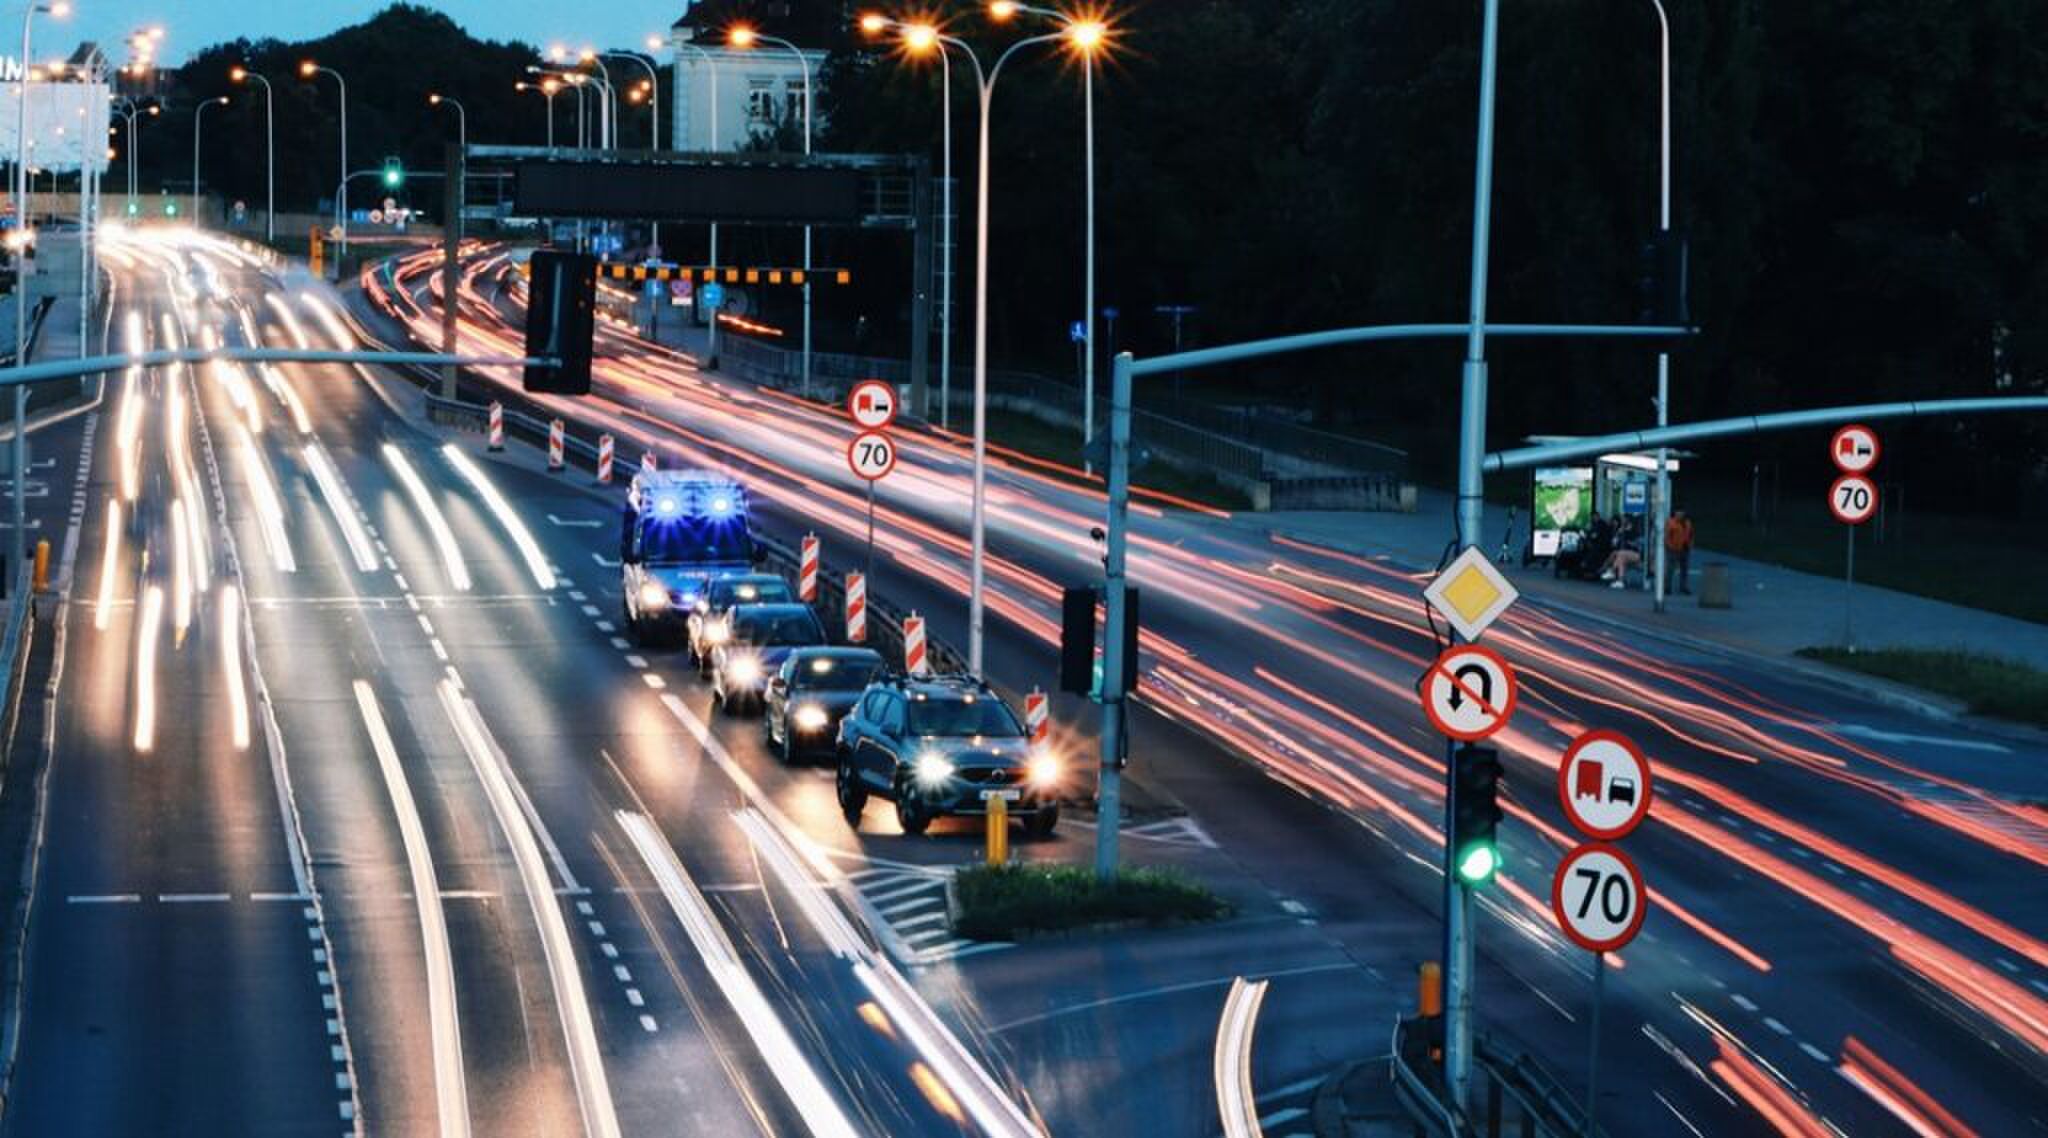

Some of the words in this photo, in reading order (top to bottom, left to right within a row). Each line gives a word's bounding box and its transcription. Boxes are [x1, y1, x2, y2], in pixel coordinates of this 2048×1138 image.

[860, 443, 888, 467] 70
[1839, 486, 1869, 511] 70
[1575, 867, 1631, 925] 70
